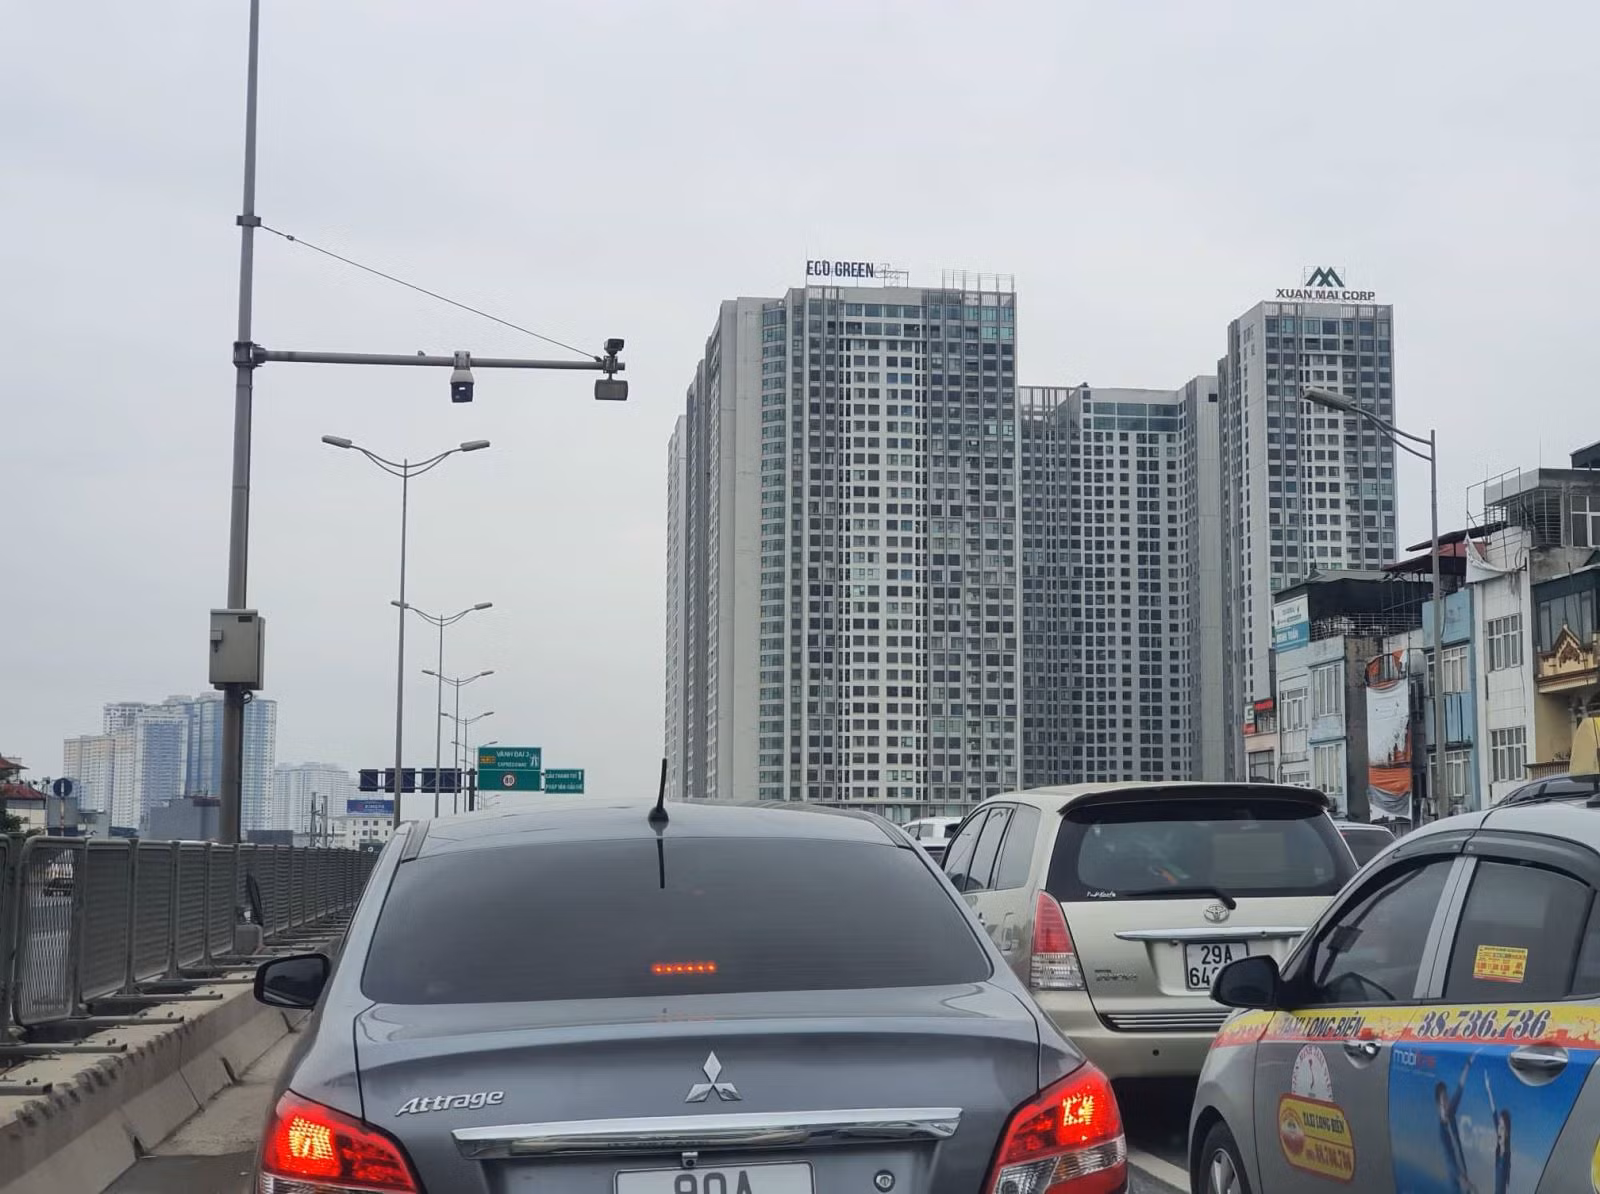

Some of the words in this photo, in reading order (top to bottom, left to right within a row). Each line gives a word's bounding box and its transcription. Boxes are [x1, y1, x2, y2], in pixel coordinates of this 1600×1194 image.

[806, 260, 830, 276] ECO
[835, 261, 874, 278] GREEN
[1276, 288, 1312, 300] XUAN
[1315, 290, 1339, 300] MAI
[1342, 291, 1375, 301] CORP
[1201, 944, 1233, 965] 29A
[1189, 966, 1220, 987] 64
[1279, 1016, 1304, 1038] TAXI
[1304, 1016, 1335, 1038] LONG
[1335, 1010, 1366, 1038] BIÊN
[1416, 1009, 1551, 1039] 38.736.736
[395, 1090, 505, 1118] Attrage
